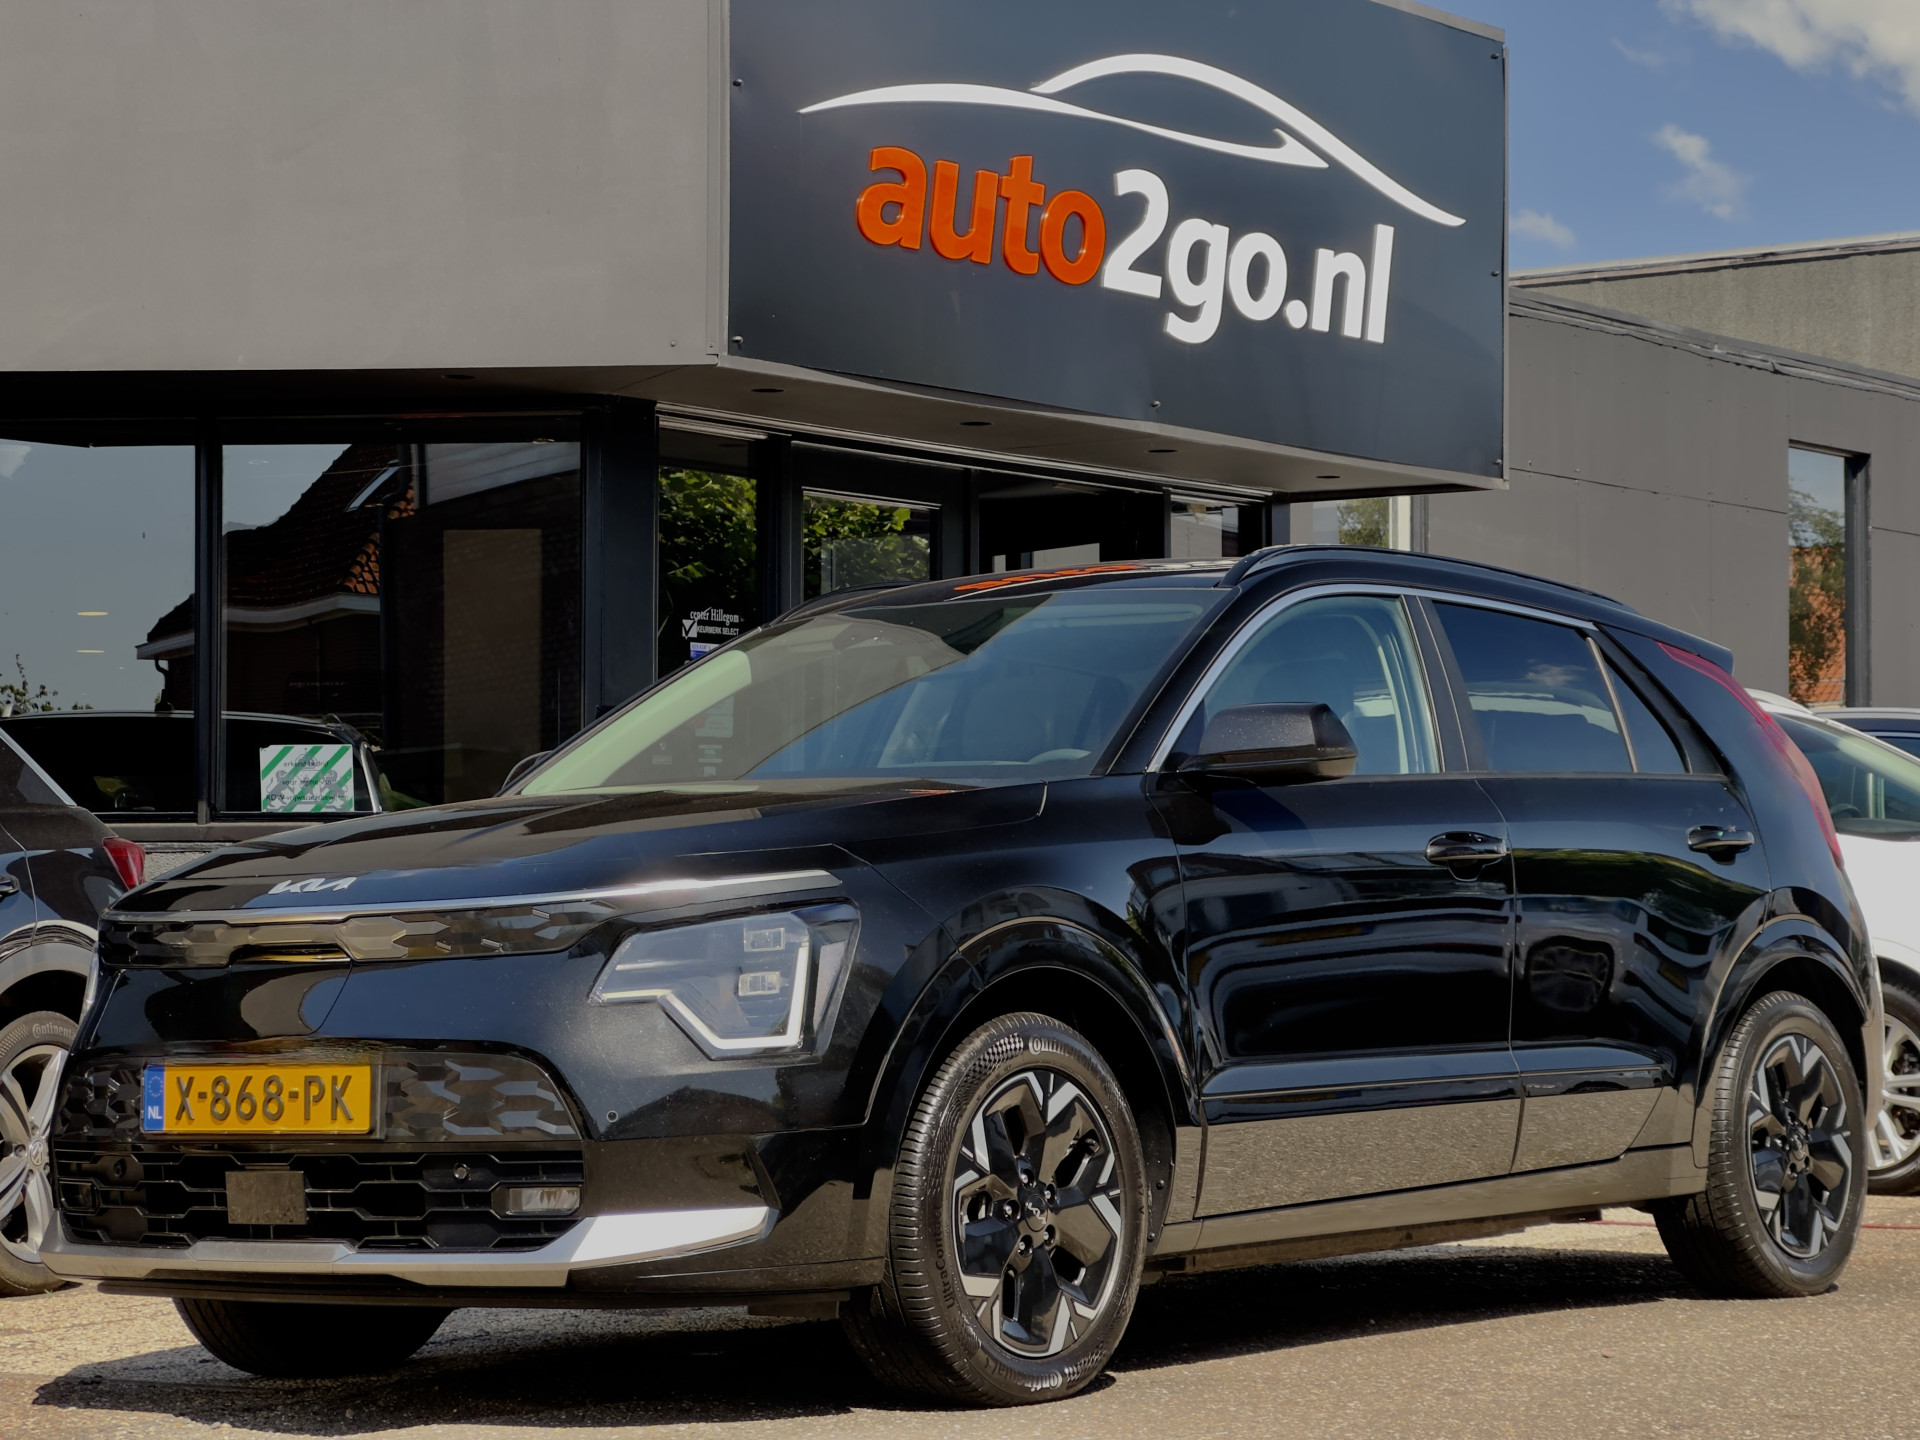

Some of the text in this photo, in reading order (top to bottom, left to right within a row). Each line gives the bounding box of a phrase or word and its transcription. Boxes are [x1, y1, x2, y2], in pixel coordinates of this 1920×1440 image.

[856, 145, 1395, 344] auto2go.nl
[710, 608, 739, 626] Hillegom
[697, 625, 739, 636] KEURMERK SELECT
[175, 1075, 354, 1121] X-868-PK
[147, 1105, 163, 1120] NL
